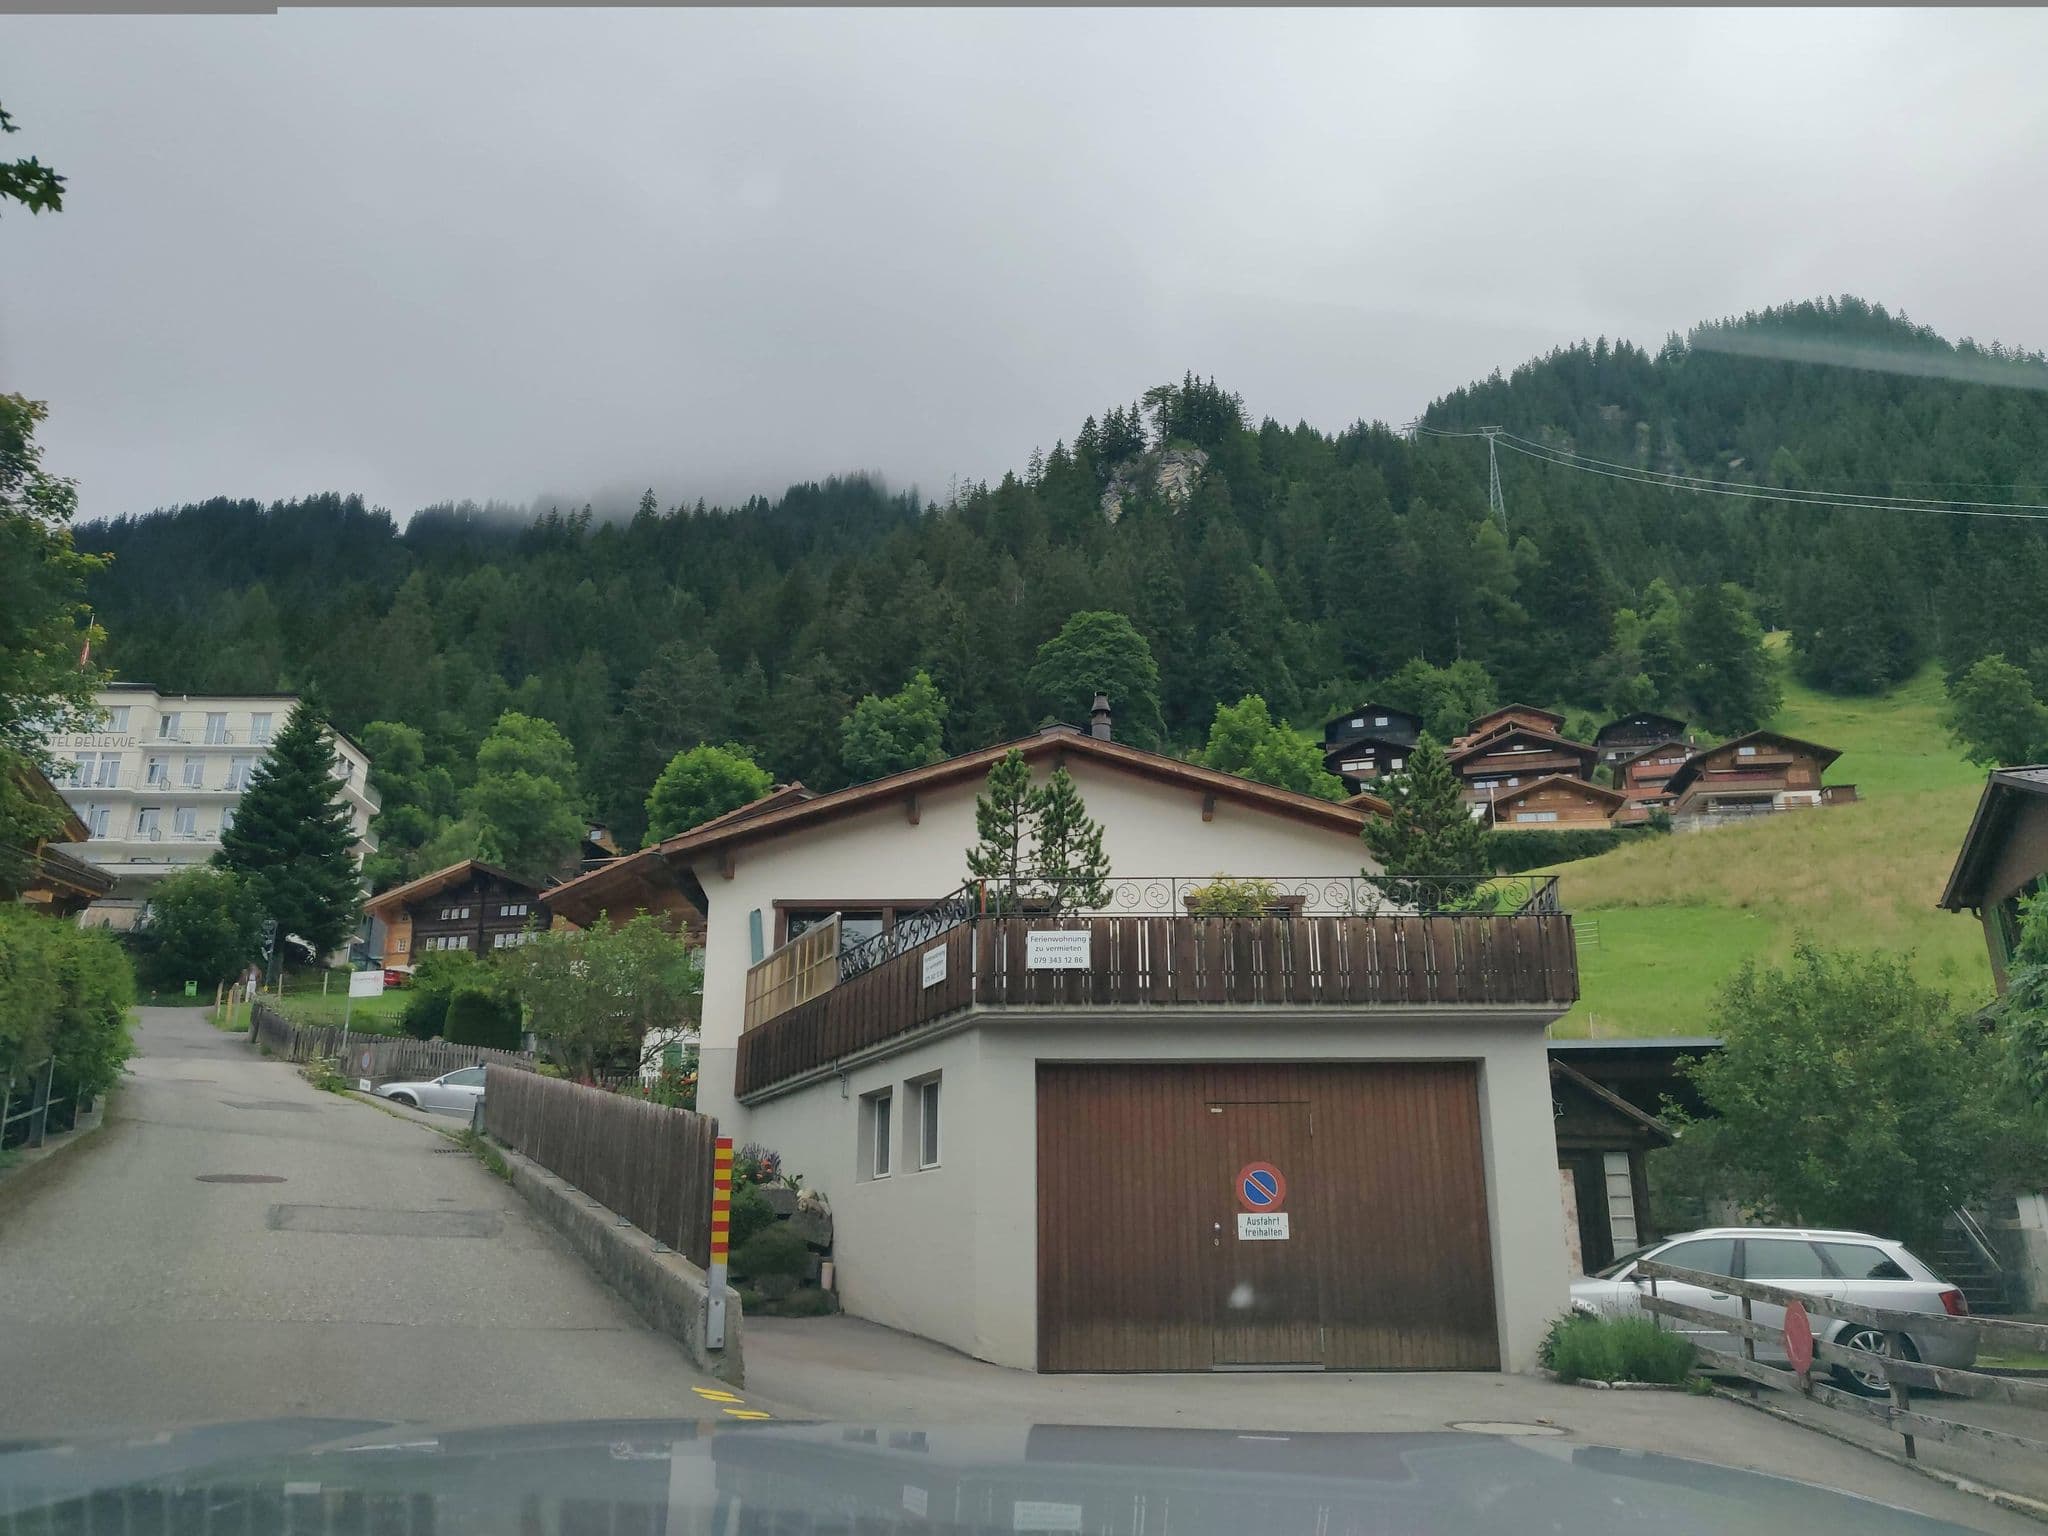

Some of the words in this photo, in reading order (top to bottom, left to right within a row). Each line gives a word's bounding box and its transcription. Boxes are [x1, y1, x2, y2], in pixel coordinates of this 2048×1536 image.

[75, 736, 135, 747] BELLEVUE
[1030, 935, 1087, 944] Ferienwohnung
[1033, 956, 1047, 964] 079
[1064, 956, 1072, 964] 12
[1246, 1216, 1280, 1226] Ausfahrt
[1245, 1227, 1282, 1237] freihalten
